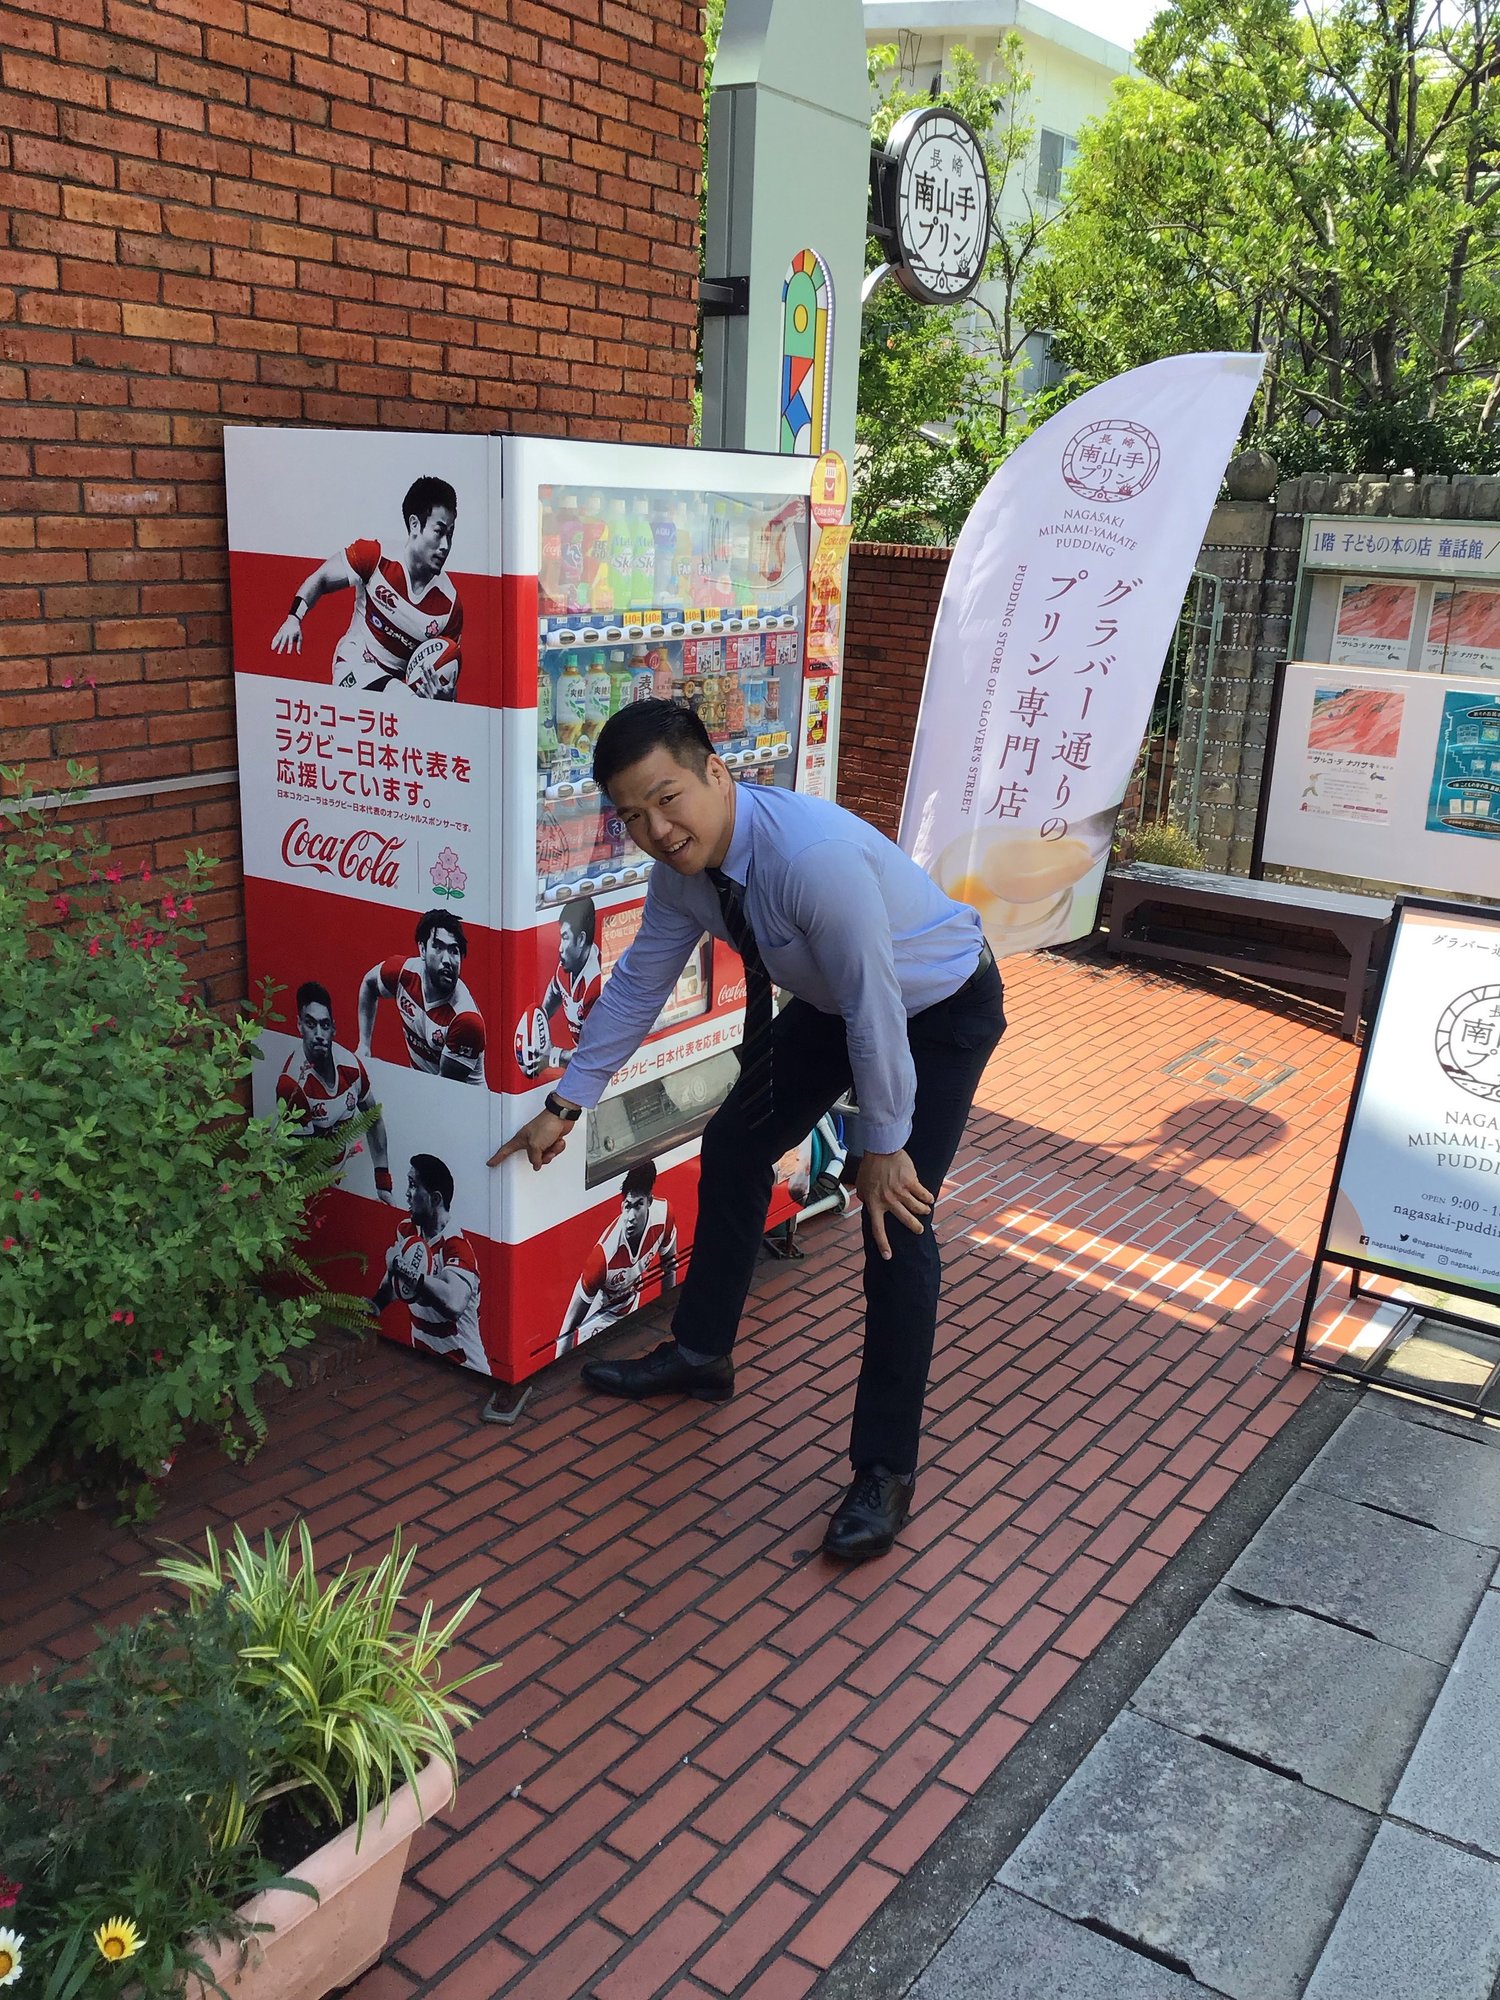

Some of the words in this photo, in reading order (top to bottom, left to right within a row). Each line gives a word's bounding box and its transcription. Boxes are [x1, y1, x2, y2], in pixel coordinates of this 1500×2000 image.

[930, 149, 964, 178] 長崎
[915, 170, 976, 222] 南山手
[919, 216, 970, 257] プリン
[1079, 443, 1145, 469] 南山手
[1100, 433, 1135, 449] 長崎
[1079, 464, 1136, 485] プリン
[1039, 524, 1138, 551] MINAMI-YAMATE
[1063, 509, 1125, 528] NAGASAKI
[1056, 538, 1116, 557] PUDDING
[1313, 533, 1336, 551] 1階
[1342, 534, 1432, 557] 子どもの本の店
[1438, 537, 1484, 560] 童話館
[1002, 565, 1027, 627] PUDDING
[990, 631, 1008, 675] STORE
[985, 569, 1088, 819] プリン専門店
[986, 678, 997, 697] OF
[276, 697, 398, 738] コカ・コーラは
[1040, 577, 1143, 842] グラバー通りの
[972, 700, 993, 763] GLOVER'S
[276, 728, 471, 783] ラグビー日本代表を
[277, 758, 431, 809] 応援しています。
[961, 765, 979, 814] STREET
[277, 789, 472, 833] 日本コカ・コーラはラグビー日本代表のオフィシャルスポンサーです。
[281, 817, 407, 888] Coca-Cola
[1421, 1193, 1446, 1204] OPEN
[1451, 1196, 1479, 1212] 9:00
[1371, 1240, 1425, 1259] nagasakipudding
[1412, 1237, 1472, 1259] @nagasakipudding
